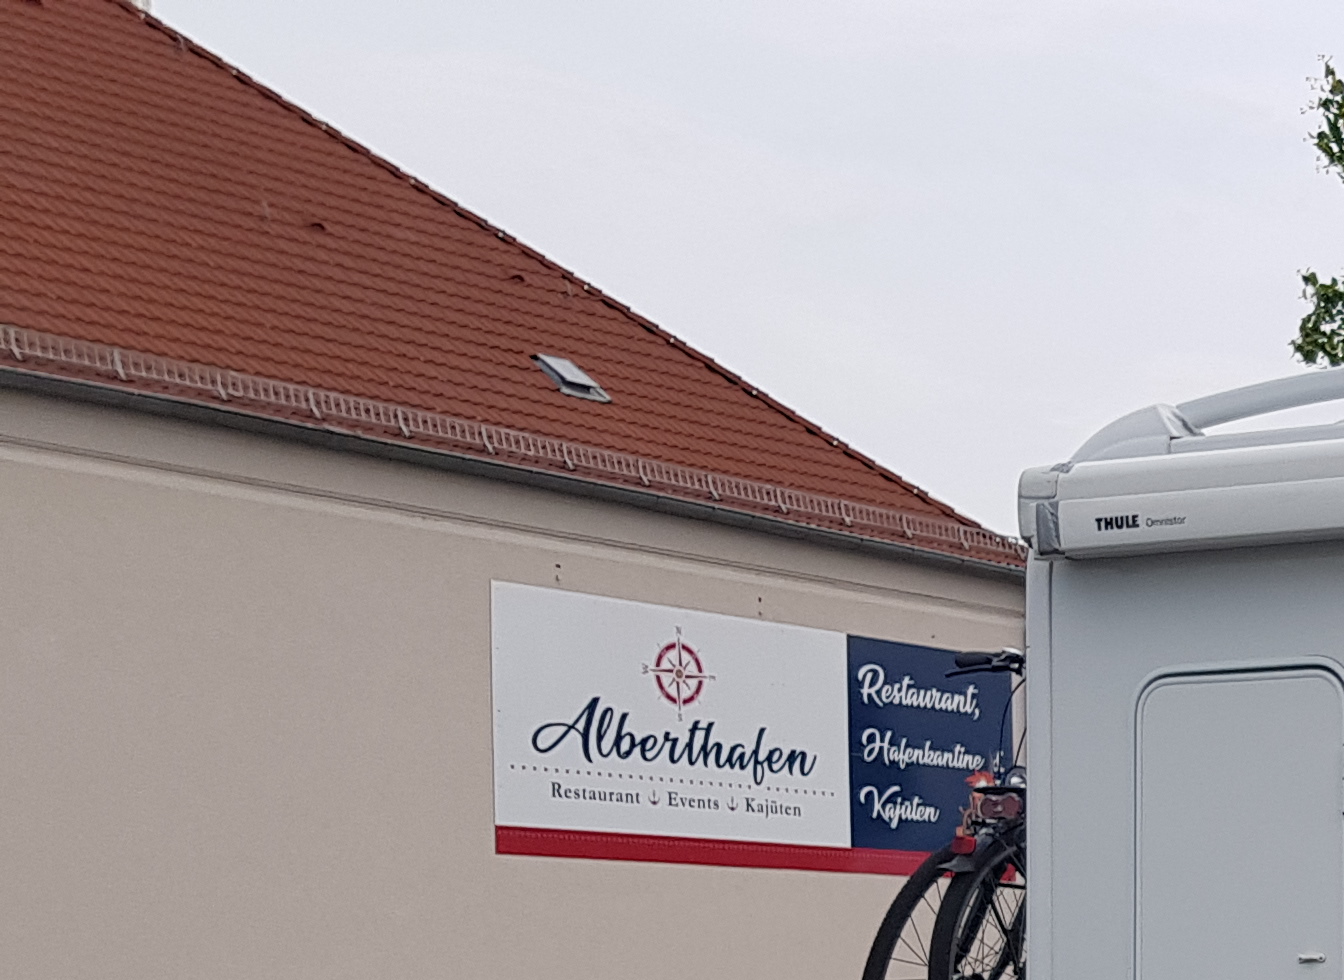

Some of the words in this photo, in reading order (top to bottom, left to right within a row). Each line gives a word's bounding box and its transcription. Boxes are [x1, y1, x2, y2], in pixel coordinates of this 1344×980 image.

[1095, 514, 1140, 531] THULE
[857, 664, 980, 720] Restaurant,
[531, 696, 817, 786] Alberthafen
[861, 727, 986, 770] Hafenkantine
[550, 781, 641, 805] Restaurant
[667, 791, 720, 811] Events
[744, 796, 802, 819] Kajüten
[859, 785, 940, 829] Kajüten
